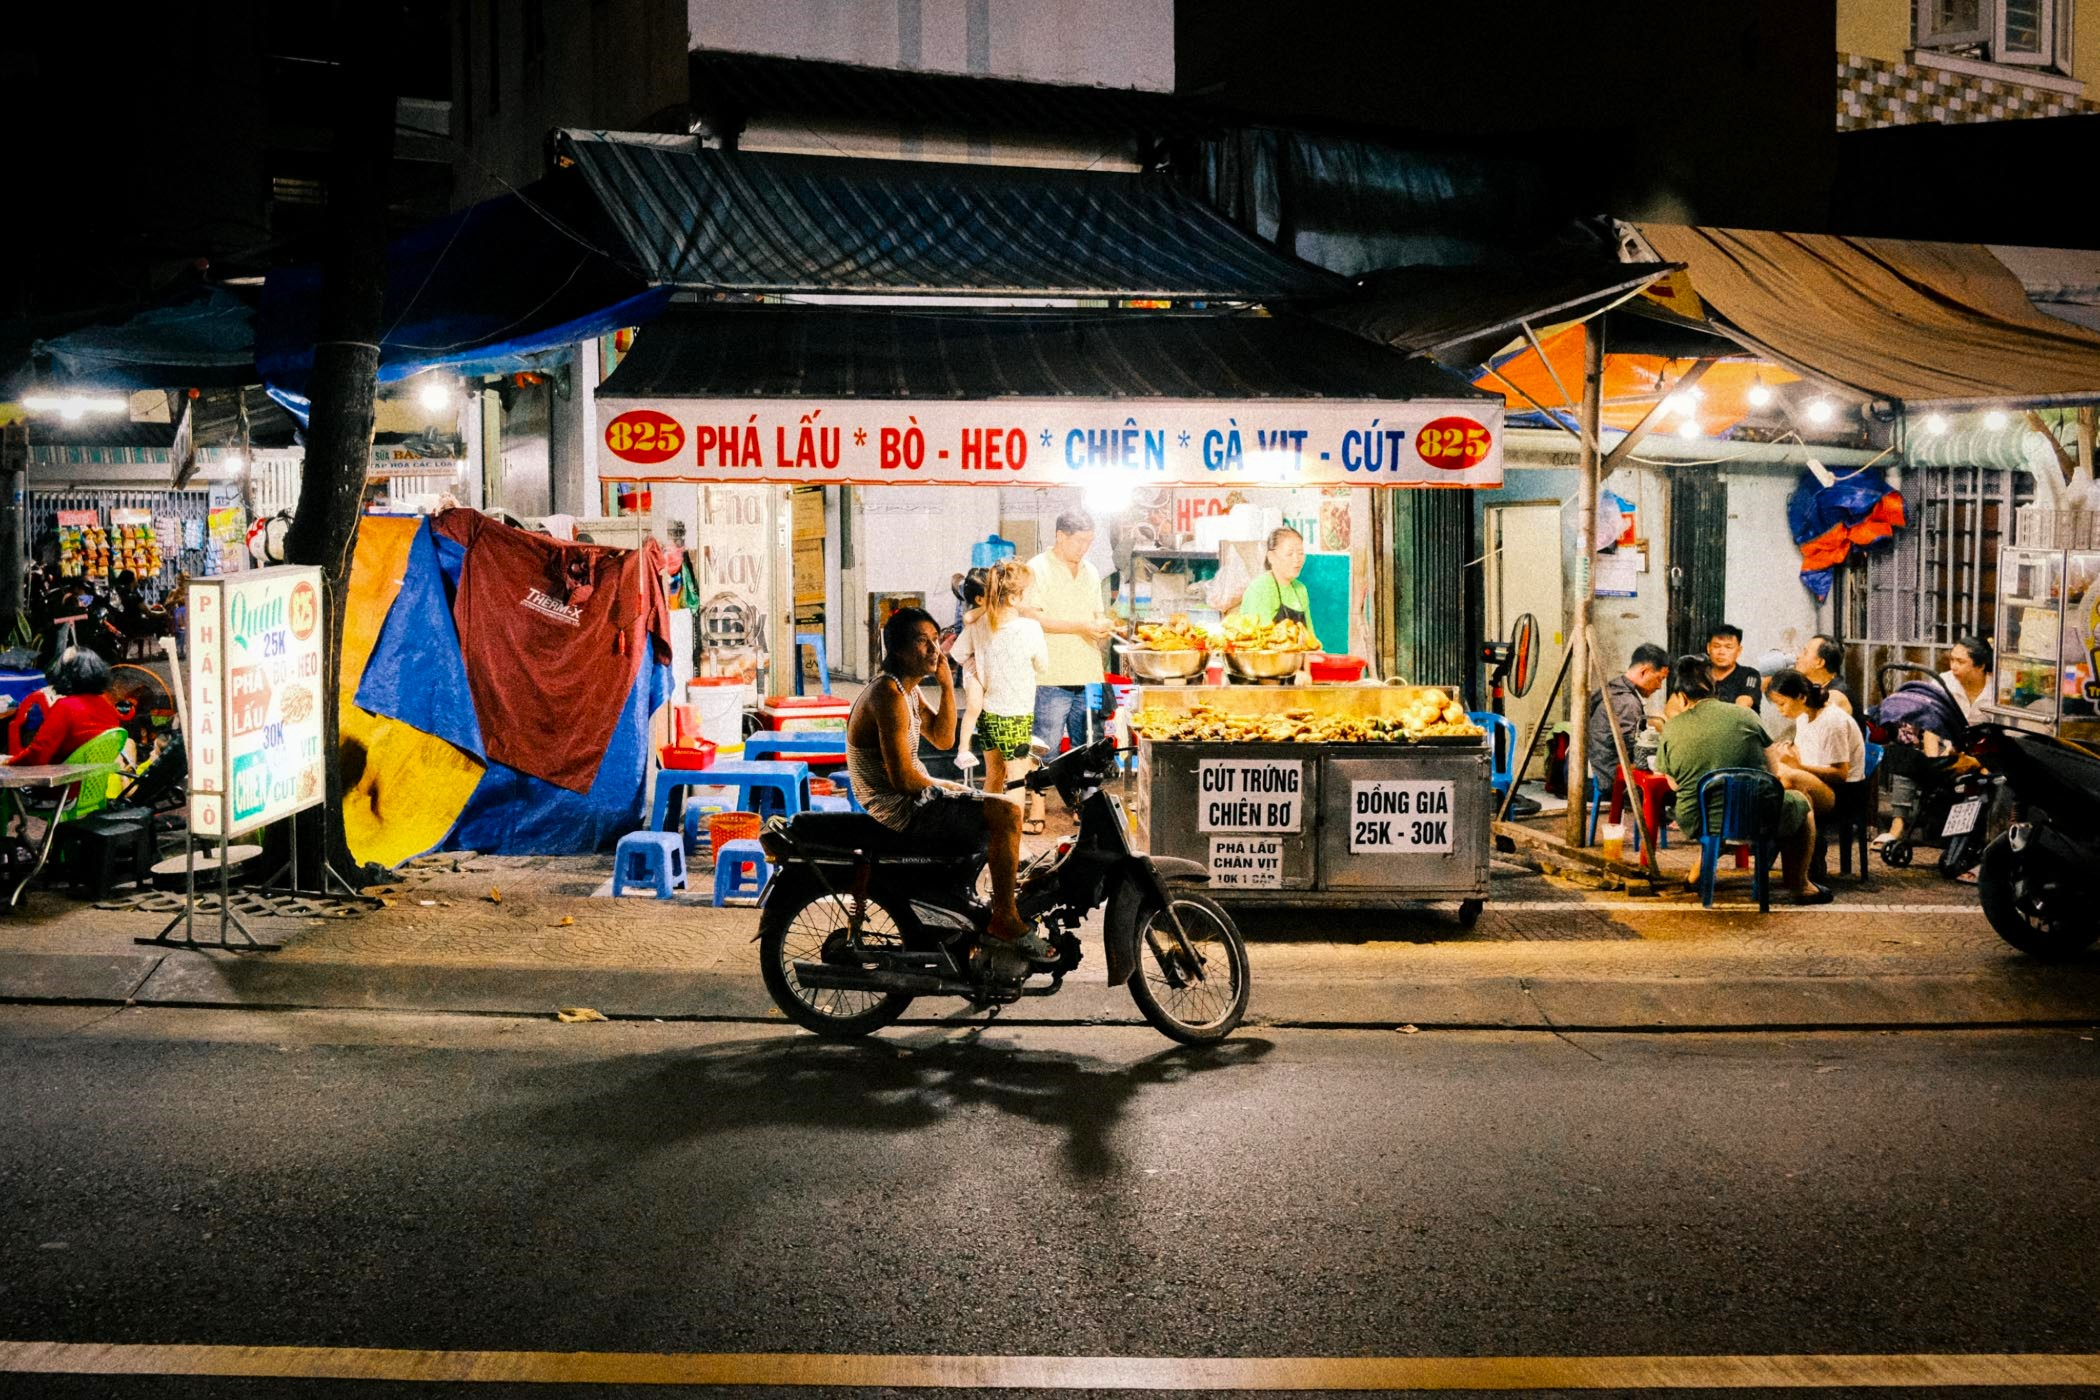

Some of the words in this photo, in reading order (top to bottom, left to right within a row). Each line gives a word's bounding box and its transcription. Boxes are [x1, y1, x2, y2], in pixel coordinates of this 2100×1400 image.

[609, 421, 680, 451] 825
[697, 414, 762, 467] PHÁ
[776, 409, 840, 469] LẤU
[880, 415, 925, 470] BÒ
[961, 428, 1028, 471] HEO
[1065, 417, 1165, 471] CHIÊN
[1203, 417, 1243, 472] GÀ
[1341, 418, 1405, 472] CÚT
[1418, 428, 1487, 457] 825
[704, 545, 764, 594] Máy
[527, 587, 584, 619] THERM-X
[231, 586, 283, 651] Quán
[264, 630, 286, 658] 25K
[263, 721, 285, 750] 30K
[1203, 763, 1235, 792] CÚT
[1241, 763, 1298, 793] TRỨNG
[1209, 797, 1261, 826] CHIÊN
[1267, 801, 1291, 827] BƠ
[1357, 783, 1409, 814] ĐỒNG
[1416, 786, 1448, 814] GIÁ
[1216, 841, 1245, 854] PHÁ
[1249, 839, 1276, 854] LẤU
[1355, 821, 1391, 845] 25K
[1411, 821, 1447, 845] 30K
[1214, 855, 1253, 868] CHÂN
[1258, 858, 1279, 871] VỊT
[1217, 874, 1238, 884] 10K
